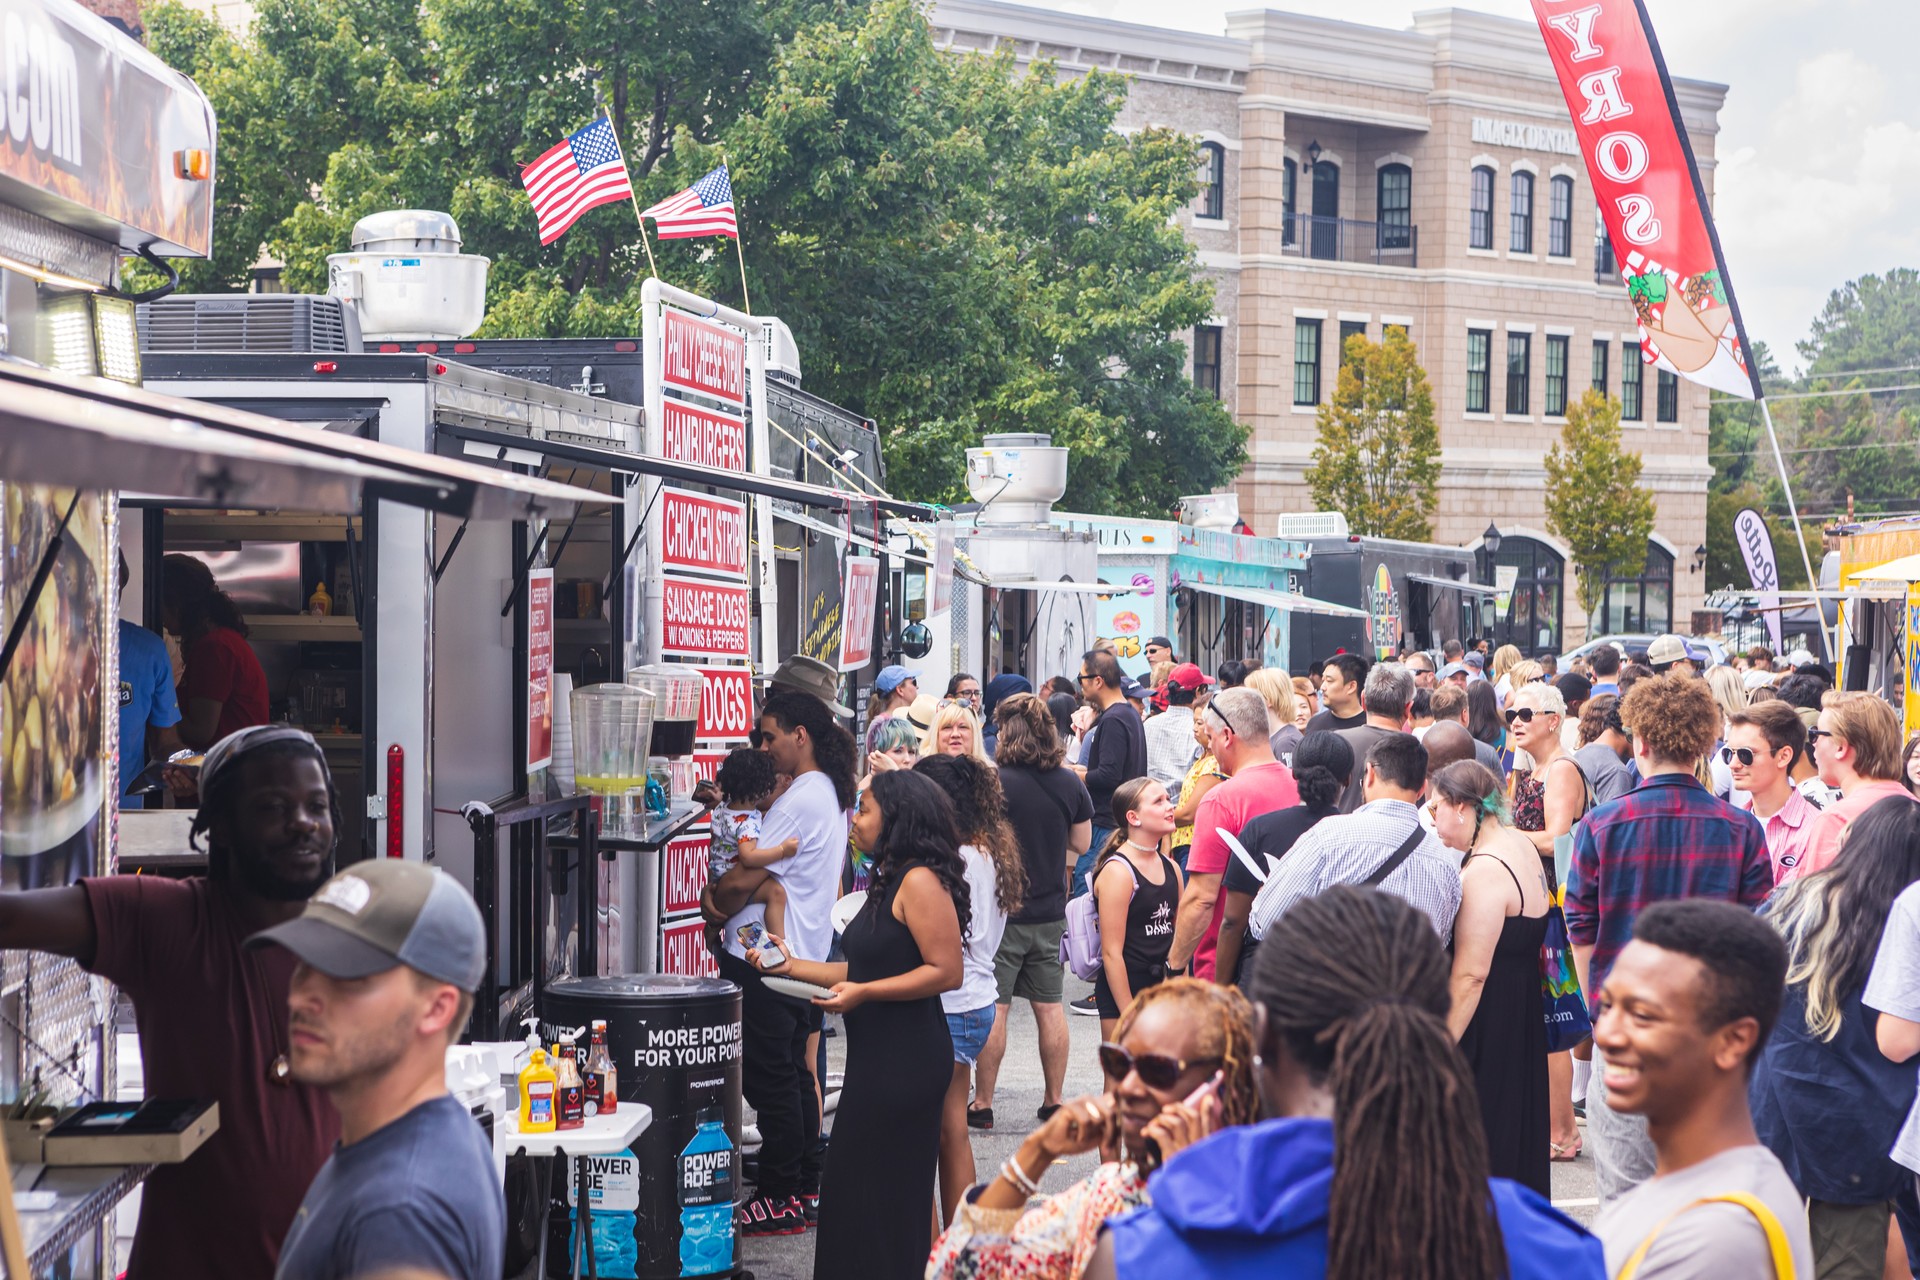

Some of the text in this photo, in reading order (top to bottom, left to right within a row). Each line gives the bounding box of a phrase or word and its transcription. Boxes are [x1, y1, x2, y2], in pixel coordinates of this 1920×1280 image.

[667, 318, 744, 396] PHILLY CHEESE STEAK
[665, 408, 743, 473] HAMBURGERS
[666, 499, 746, 568] CHICKEN STRIPS
[666, 586, 746, 629] SAUSAGE DOGS
[668, 625, 745, 650] W/ ONIONS & PEPPERS
[704, 676, 747, 732] DOGS
[669, 844, 709, 905] NACHOS
[634, 1049, 671, 1067] FOR
[674, 1044, 717, 1066] YOUR
[648, 1020, 742, 1047] MORE POWER
[684, 1149, 730, 1173] POWER
